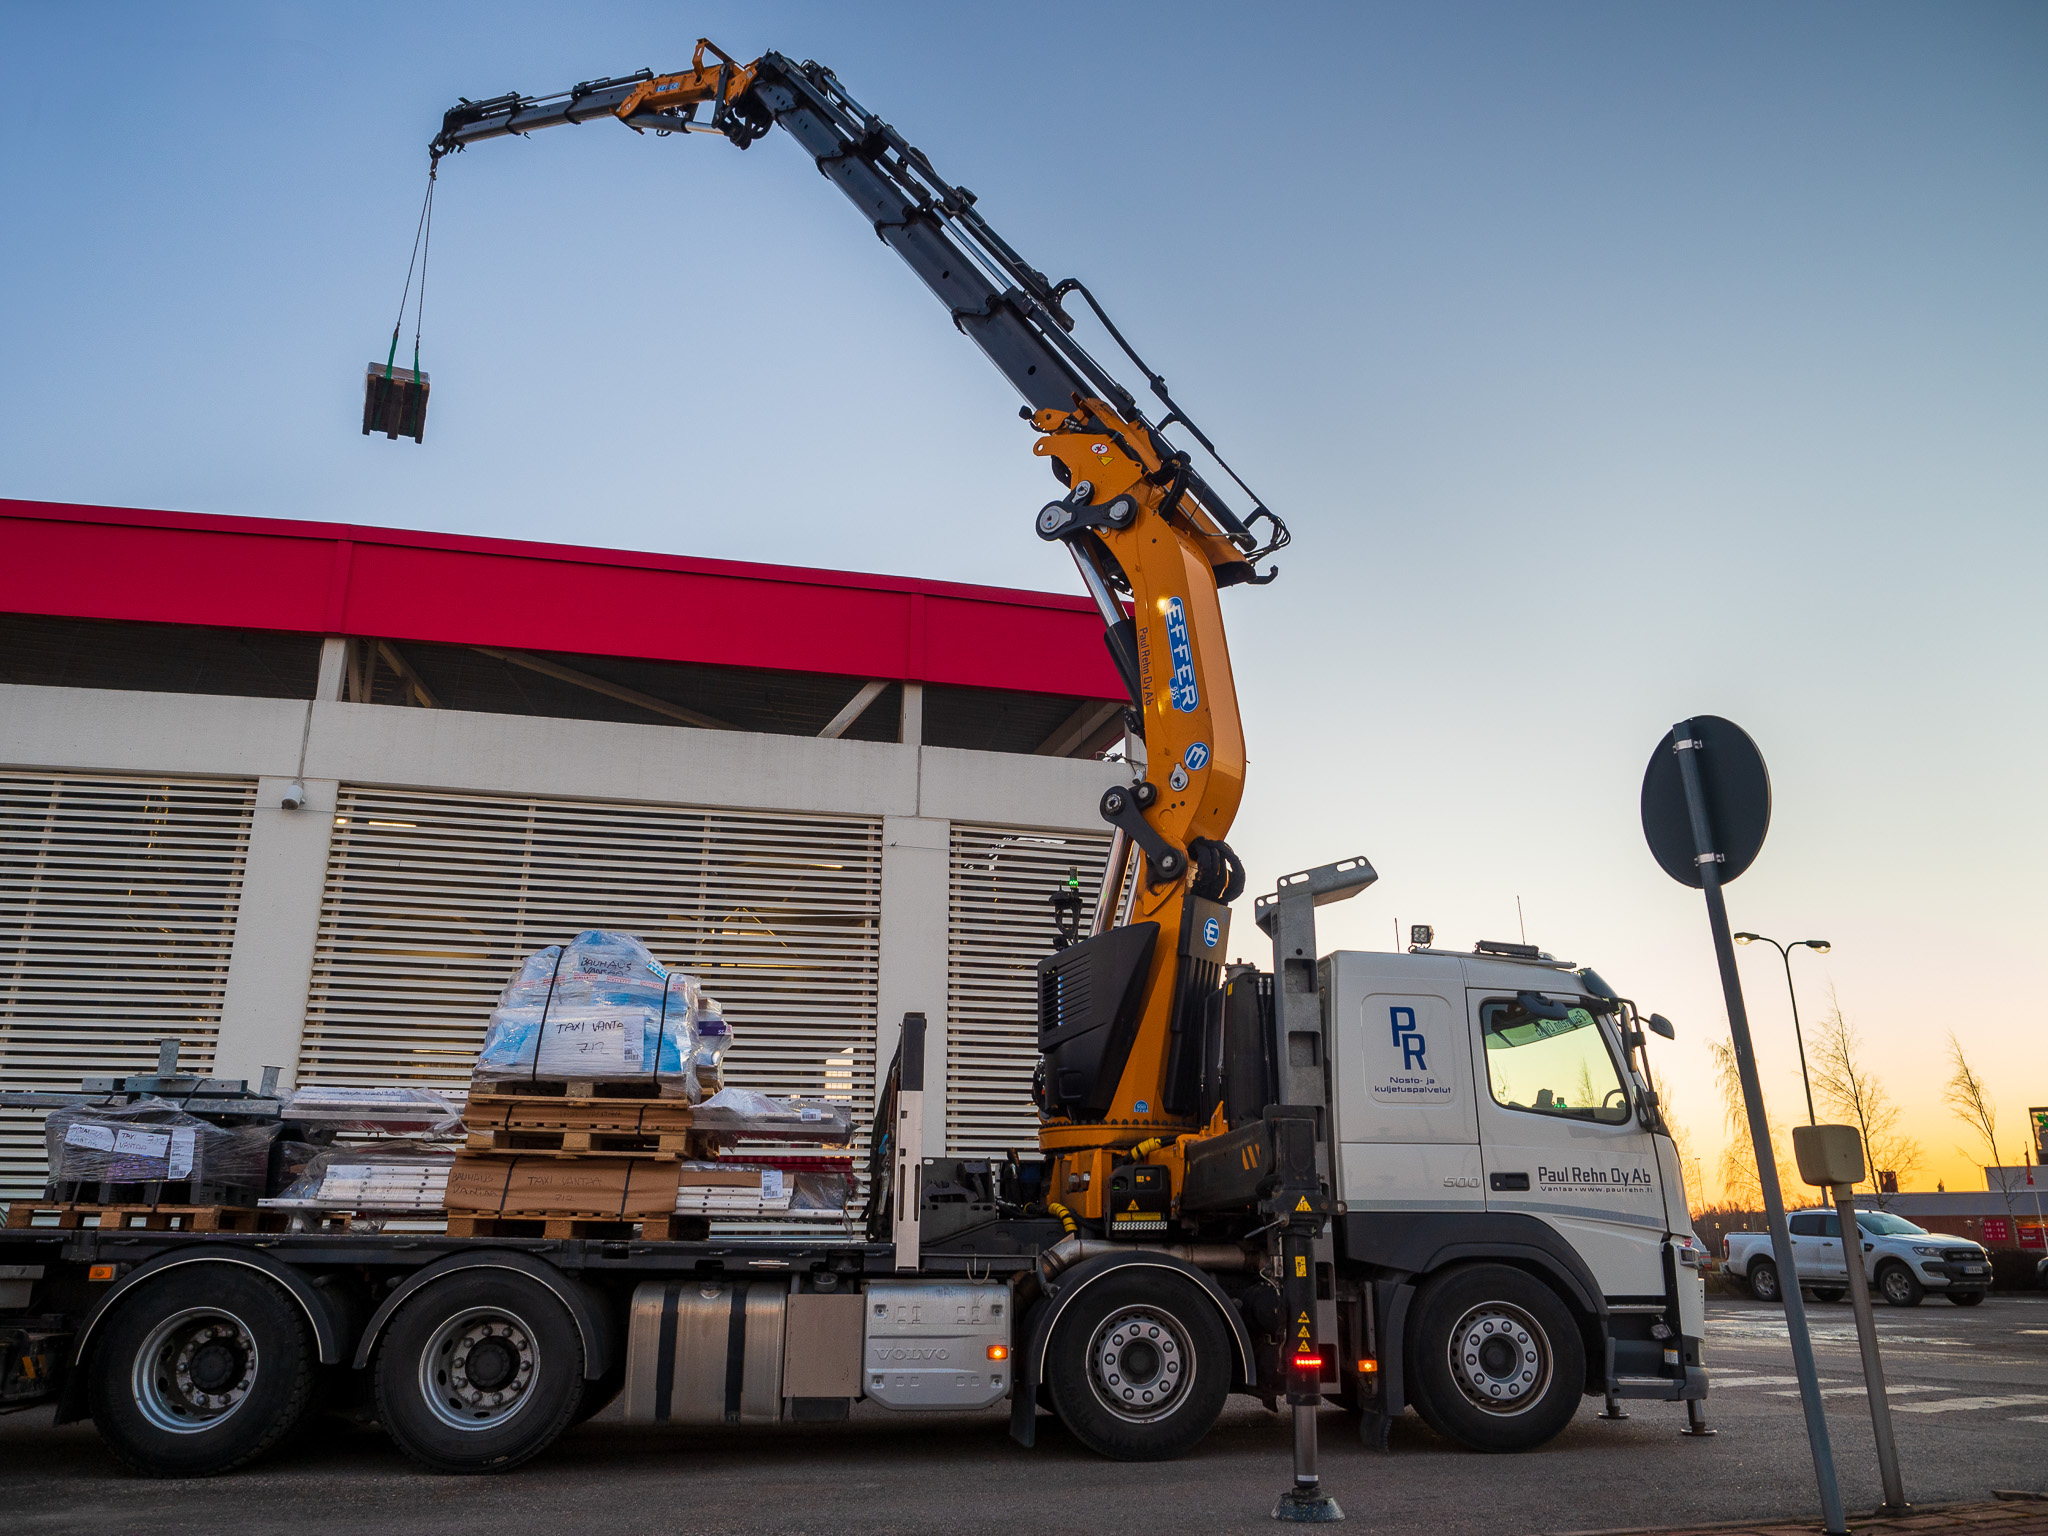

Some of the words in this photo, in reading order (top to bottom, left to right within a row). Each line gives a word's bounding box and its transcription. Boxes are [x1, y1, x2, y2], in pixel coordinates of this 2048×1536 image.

[1140, 627, 1150, 650] Paul
[1141, 651, 1151, 675] Rehn
[1166, 604, 1197, 707] EFFER
[1143, 675, 1153, 690] Oy
[1145, 689, 1155, 706] Ab
[1171, 685, 1180, 700] 955
[580, 956, 632, 972] BAUHAUS
[556, 1022, 584, 1034] TAXI
[1389, 1076, 1423, 1084] Nosto-
[1426, 1077, 1435, 1085] ja
[1374, 1085, 1451, 1094] kuljetuspalvelut
[527, 1176, 553, 1186] TAXI
[1443, 1176, 1480, 1188] 500
[1538, 1166, 1569, 1182] Paul
[1572, 1166, 1607, 1182] Rehn
[1611, 1168, 1629, 1187] Oy
[1632, 1168, 1651, 1183] Ab
[874, 1348, 951, 1361] VOLVO
